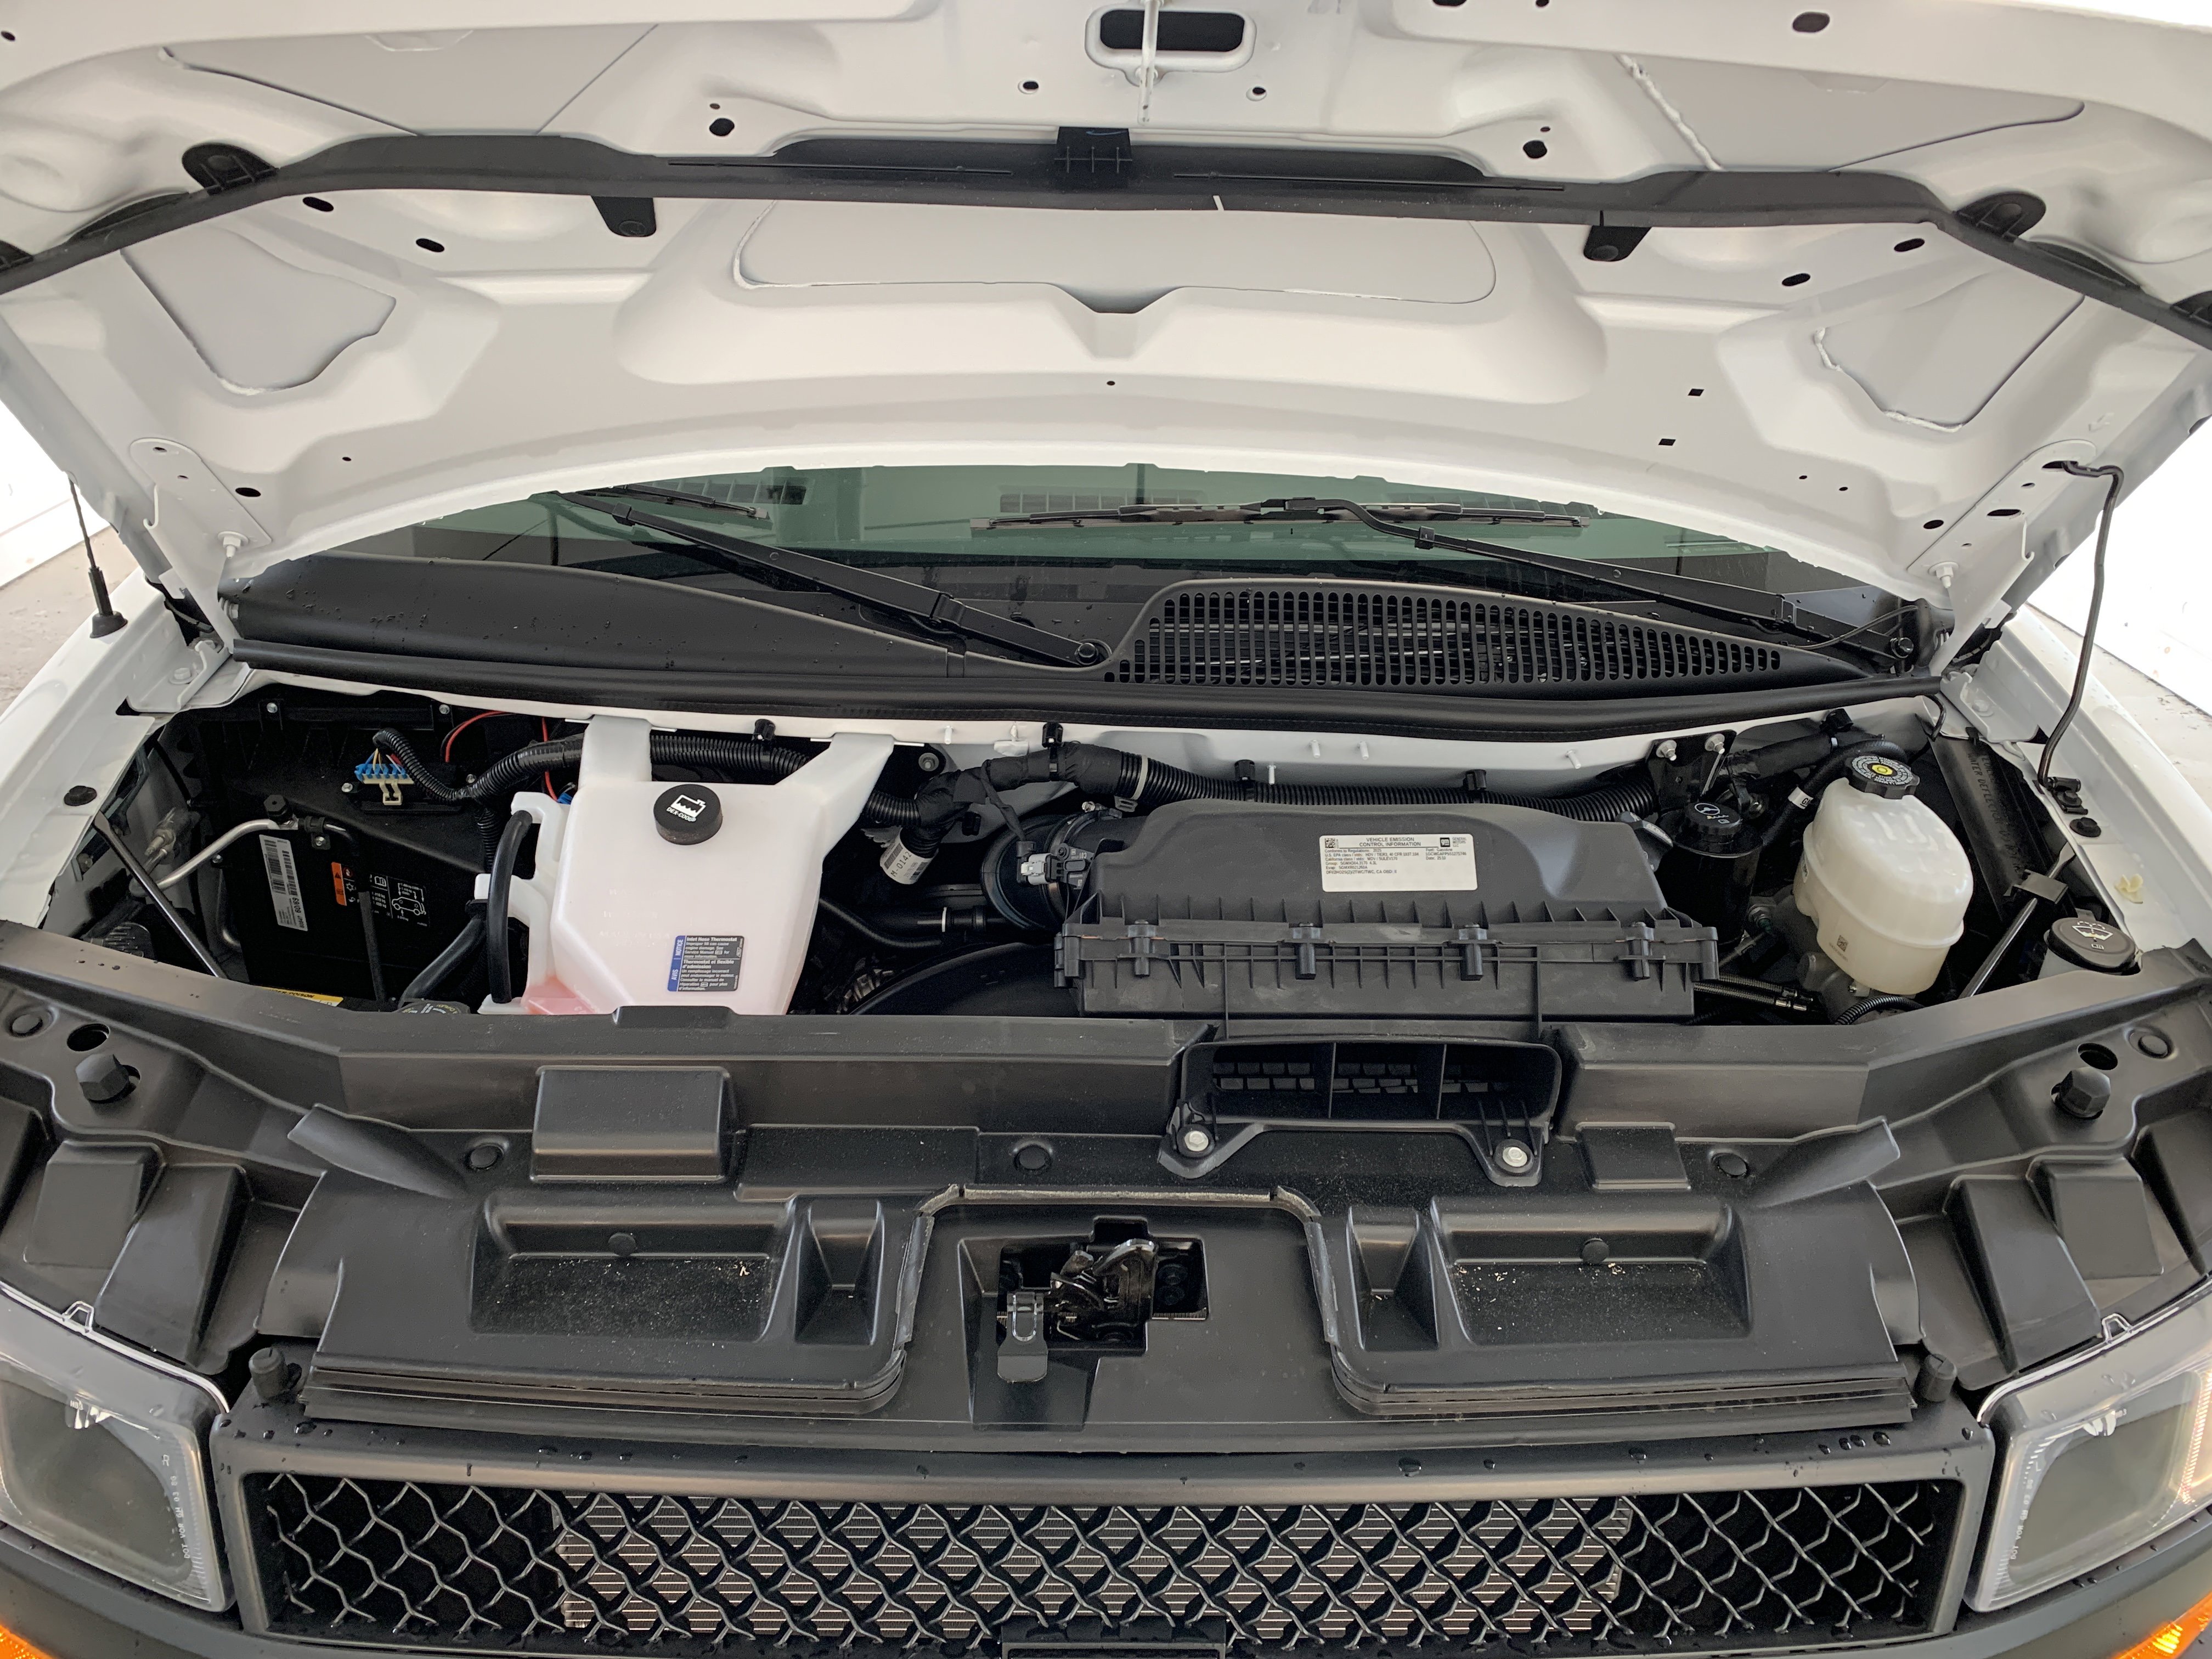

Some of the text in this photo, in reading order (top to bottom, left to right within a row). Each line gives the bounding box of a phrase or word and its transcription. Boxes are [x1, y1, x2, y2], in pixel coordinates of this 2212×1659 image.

[890, 851, 912, 877] M-0142
[675, 939, 684, 956] NOTICE
[182, 1543, 190, 1559] DOT
